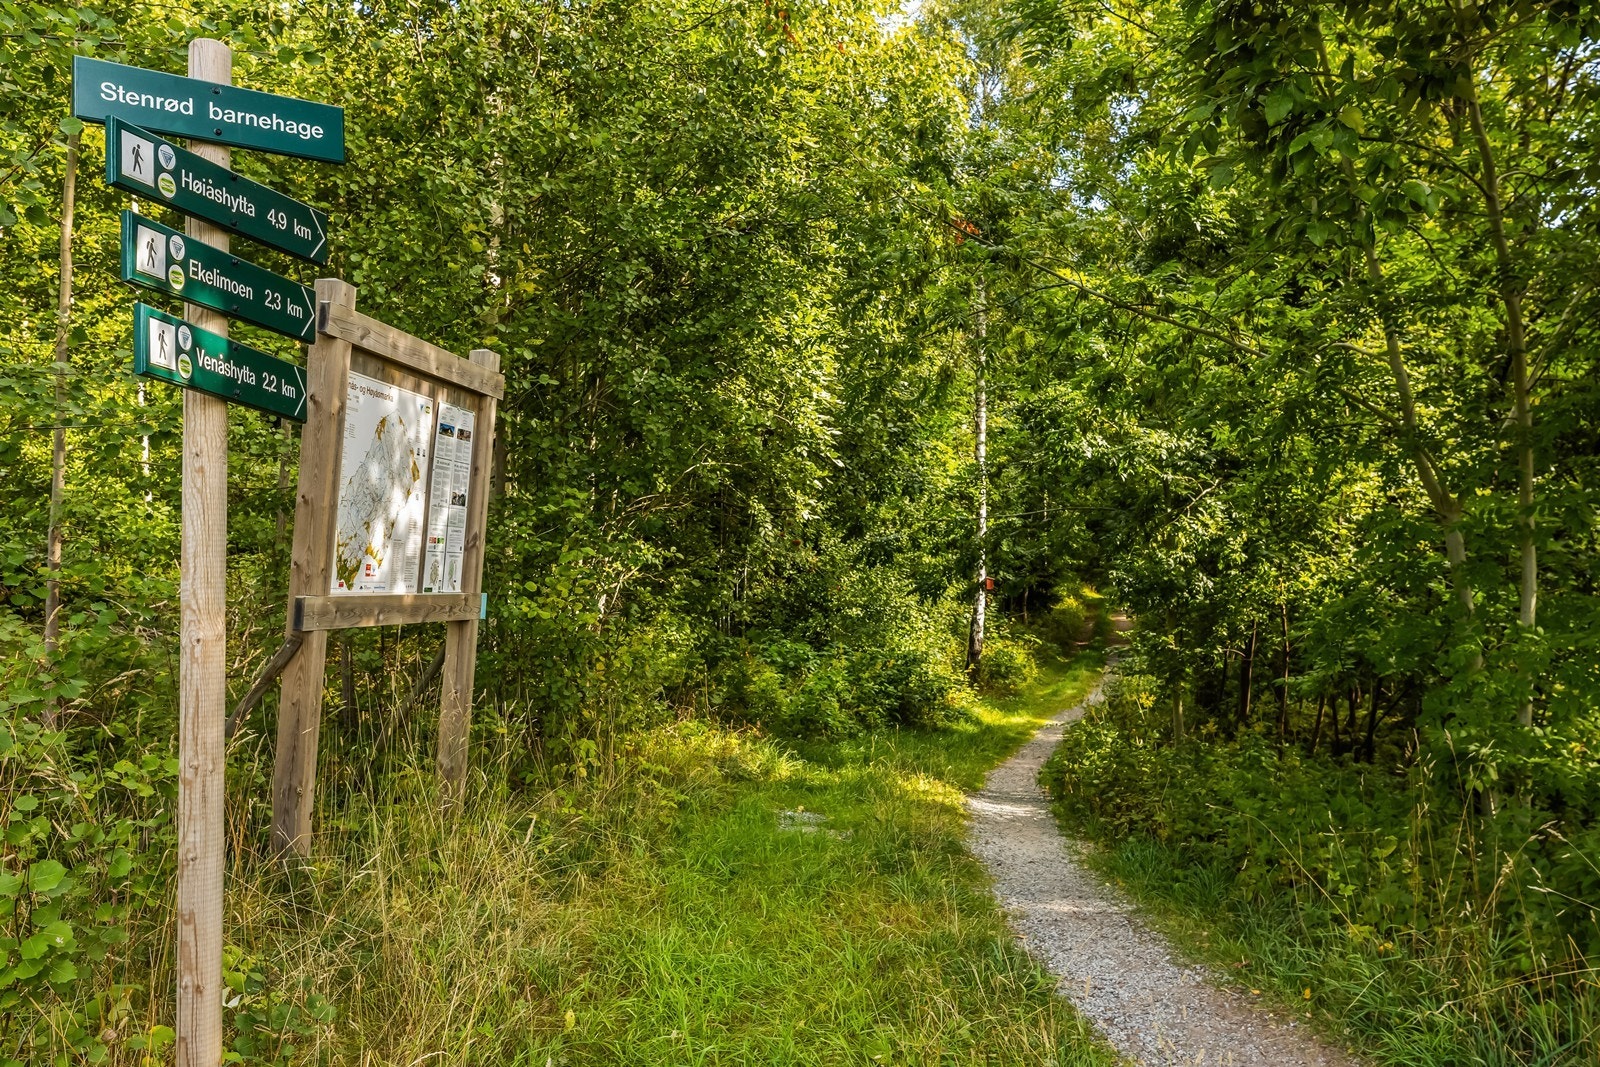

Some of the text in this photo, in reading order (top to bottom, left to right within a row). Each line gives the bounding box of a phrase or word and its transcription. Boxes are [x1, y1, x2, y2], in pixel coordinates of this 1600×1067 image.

[100, 82, 324, 139] Stenrød barnehage
[181, 169, 311, 241] Høiåshytta 4,9 km
[189, 259, 303, 318] Ekelimoen 2,3 km
[196, 347, 296, 399] Venåshytta 2,2 km
